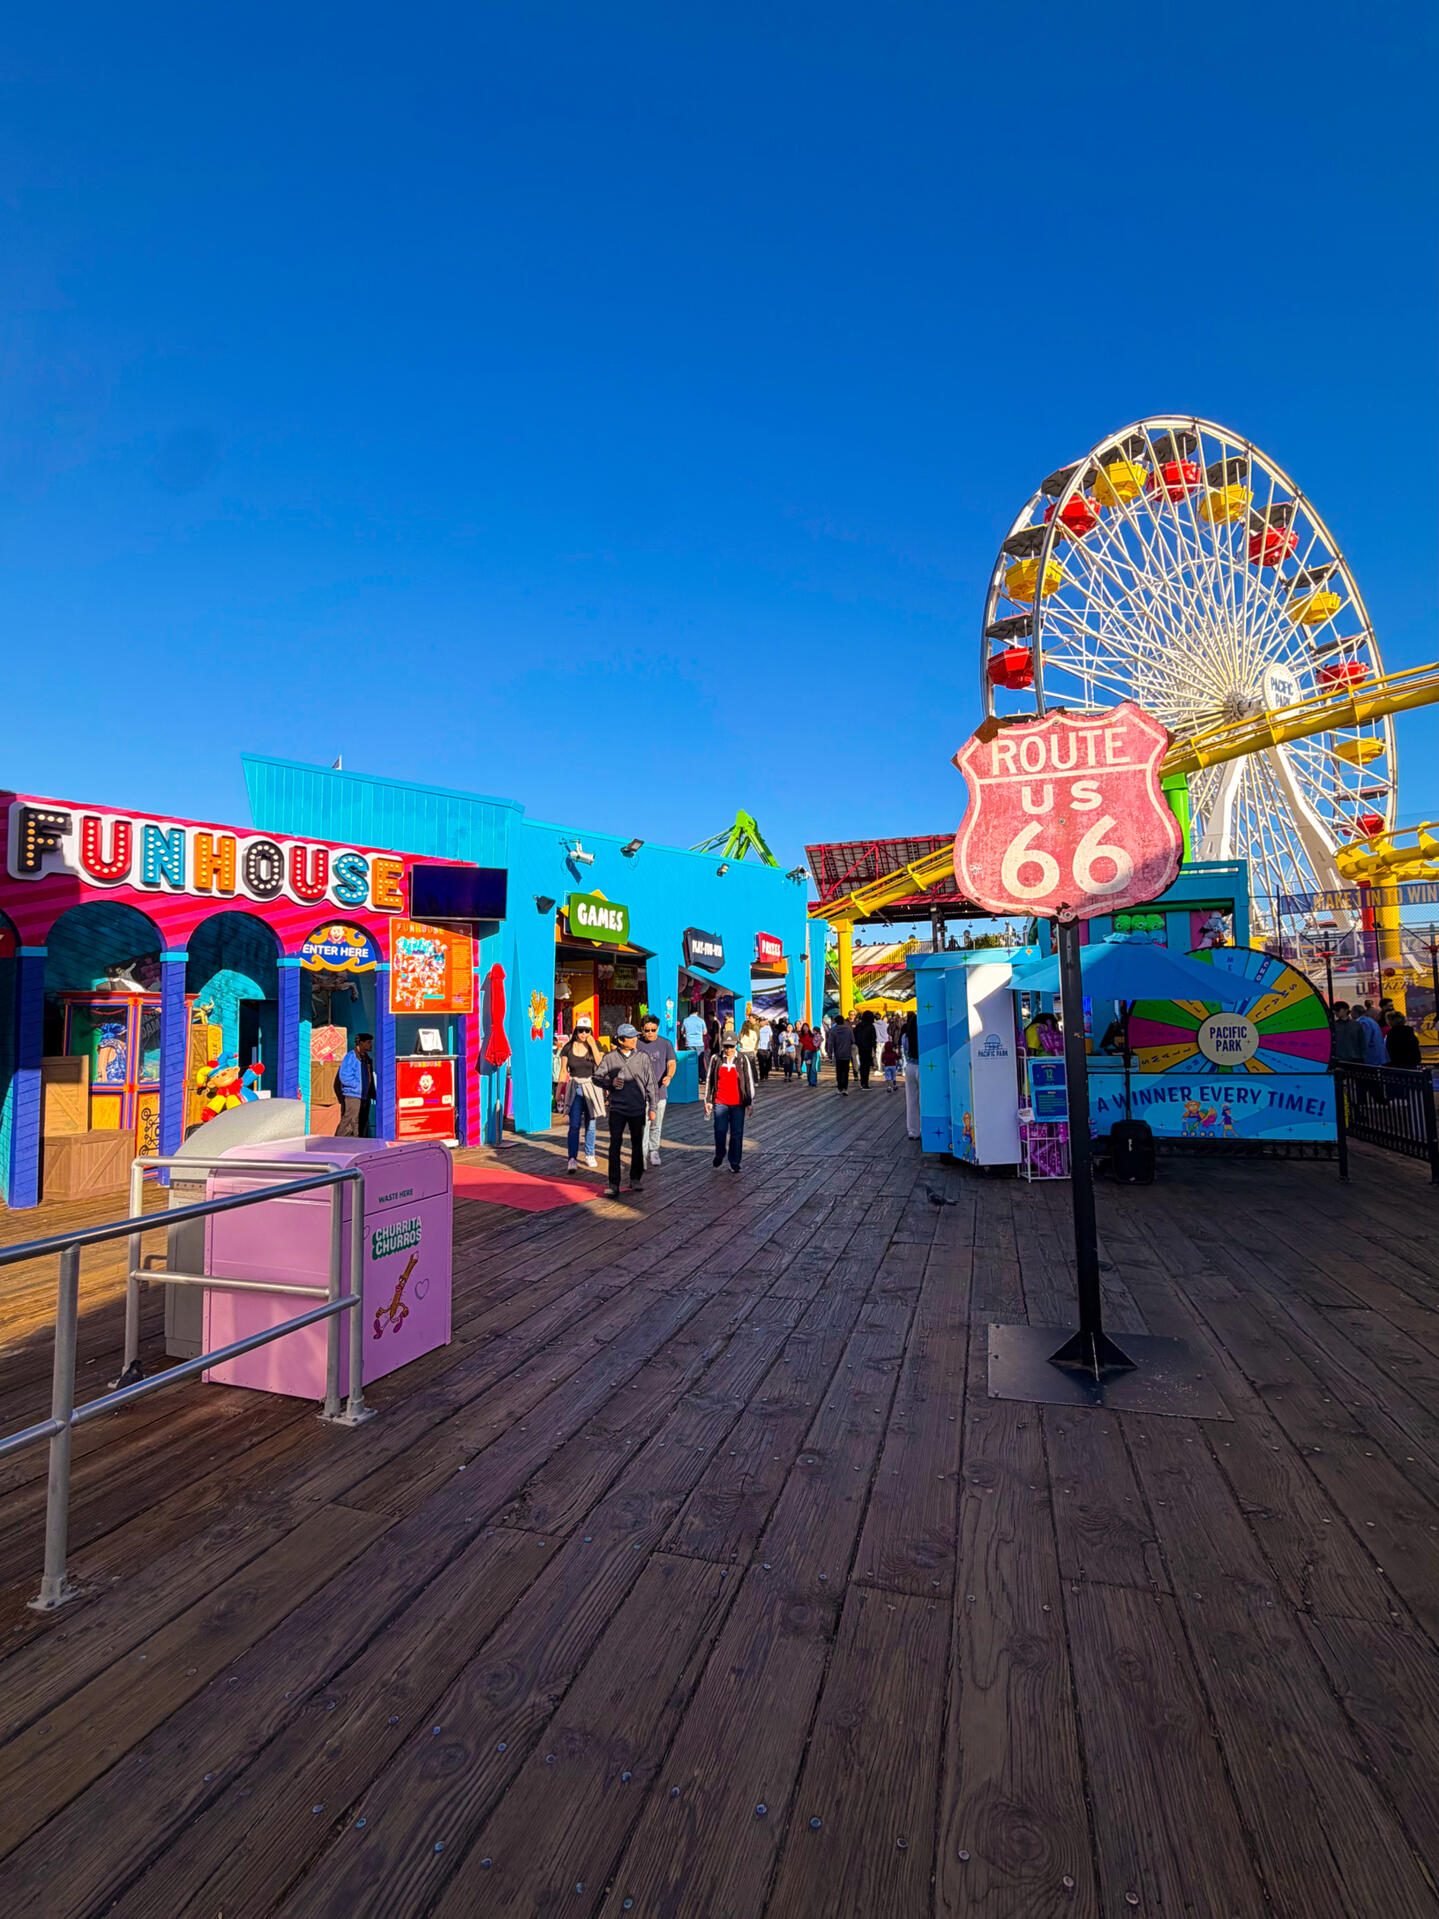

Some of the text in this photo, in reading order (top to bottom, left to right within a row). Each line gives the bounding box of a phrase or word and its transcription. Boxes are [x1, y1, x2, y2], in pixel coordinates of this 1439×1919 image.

[1271, 676, 1294, 696] PACIFIC
[992, 726, 1131, 776] ROUTE
[1022, 780, 1103, 815] U S
[18, 806, 404, 910] FUNHOUSE
[1001, 815, 1134, 899] 66
[1313, 890, 1352, 911] MAKE
[1366, 888, 1380, 907] IN
[577, 902, 624, 932] GAMES
[302, 944, 369, 958] ENTER HERE
[1209, 1026, 1247, 1039] PACIFIC
[1215, 1039, 1242, 1052] PARK
[1097, 1086, 1326, 1117] A WINNER EVERY TIME!
[378, 1188, 414, 1203] WASTE HERE
[375, 1216, 422, 1242] CHURRITA
[375, 1228, 422, 1255] CHURROS
